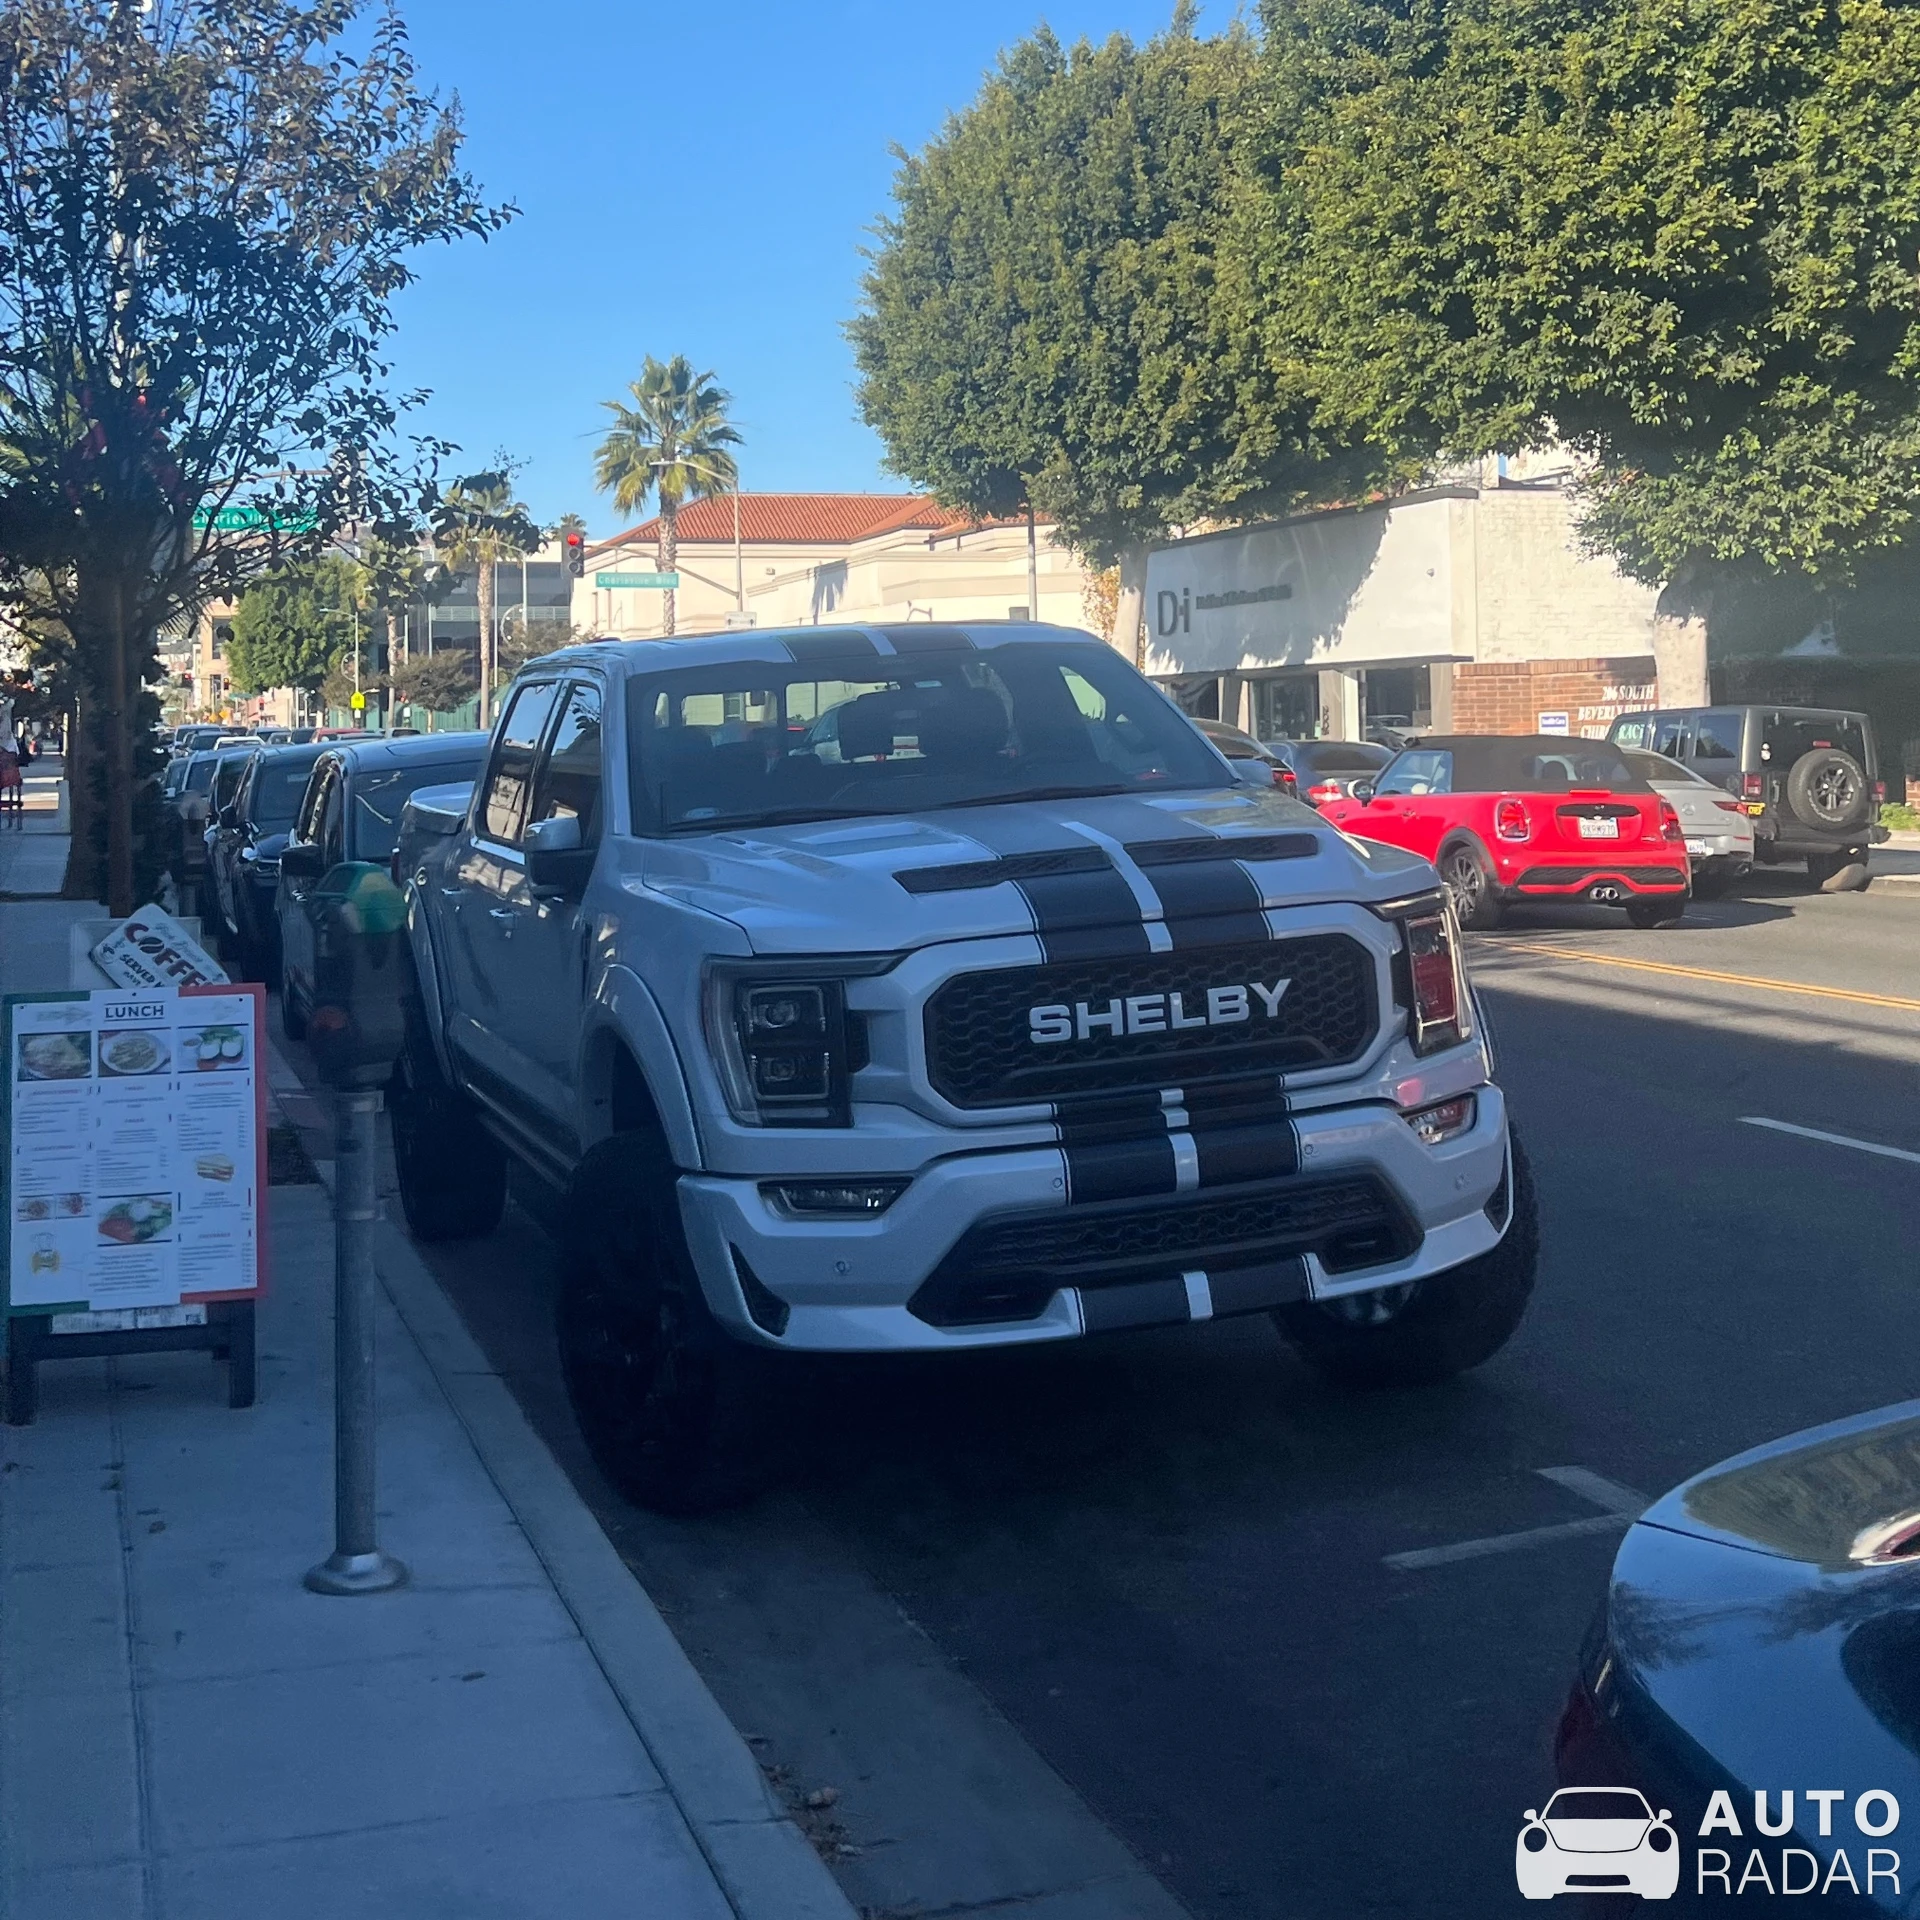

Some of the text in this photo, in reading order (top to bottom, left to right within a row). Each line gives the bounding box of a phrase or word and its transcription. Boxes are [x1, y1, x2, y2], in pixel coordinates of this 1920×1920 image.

[1619, 685, 1656, 700] SOUTH
[120, 953, 156, 983] SERVED
[124, 923, 214, 987] COFFE
[105, 1005, 164, 1019] LUNCH
[1028, 978, 1292, 1044] SHELBY
